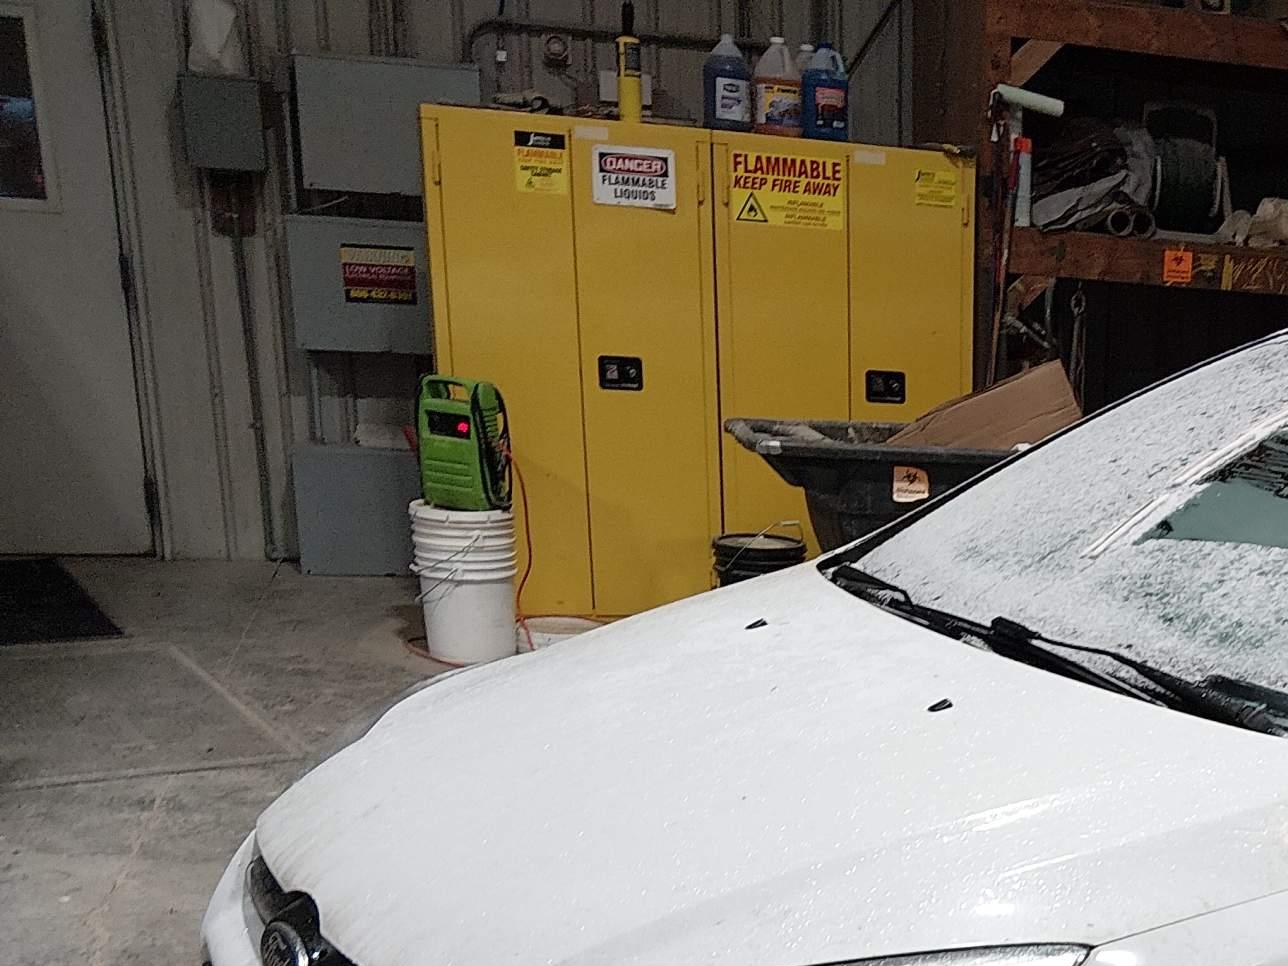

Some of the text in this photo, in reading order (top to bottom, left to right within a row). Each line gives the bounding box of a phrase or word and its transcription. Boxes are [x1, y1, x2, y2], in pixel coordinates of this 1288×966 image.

[606, 157, 662, 172] DANGER
[733, 153, 842, 181] FLAMMABLE
[602, 175, 668, 190] FLAMMABLE
[733, 175, 840, 197] KEEP FIRE AWAY
[614, 188, 657, 201] LIQUIDS
